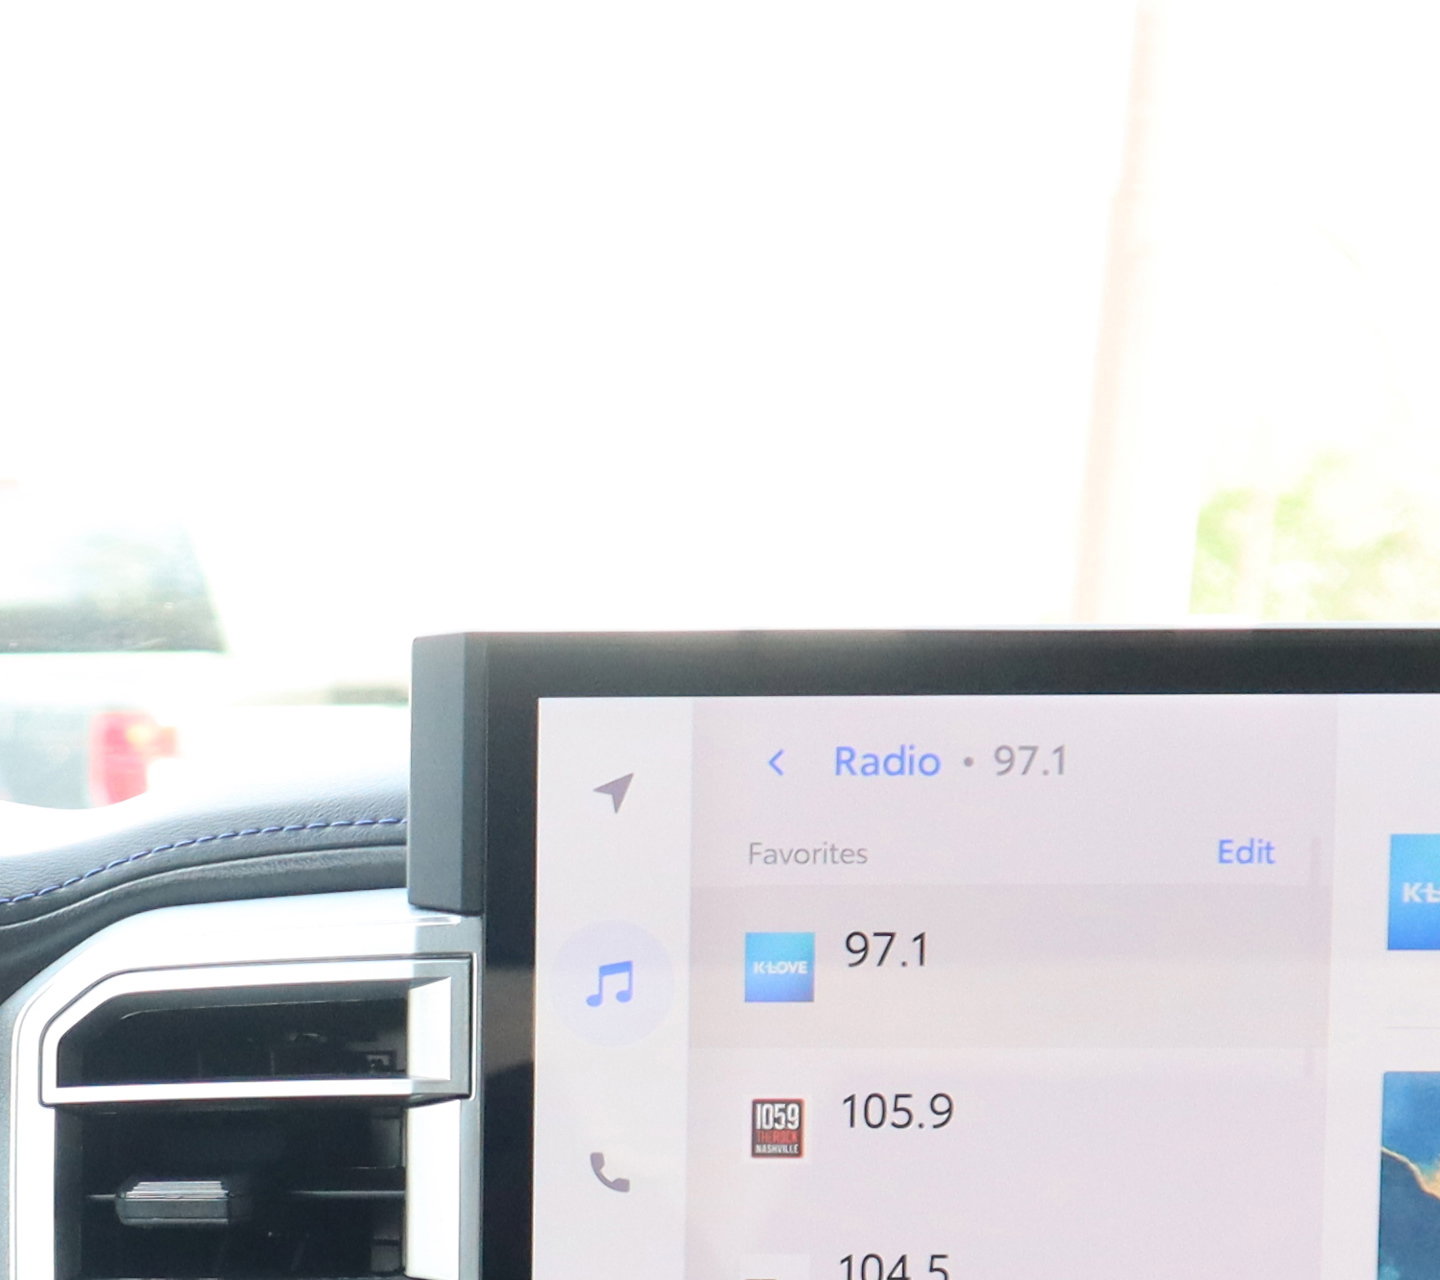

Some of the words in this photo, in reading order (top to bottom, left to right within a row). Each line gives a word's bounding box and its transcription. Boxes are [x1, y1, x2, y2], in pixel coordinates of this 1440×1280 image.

[834, 745, 941, 777] Radio
[993, 744, 1067, 777] 97.1
[747, 841, 869, 866] Favorites
[1217, 838, 1276, 864] Edit
[844, 931, 928, 968] 97.1
[840, 1093, 954, 1131] 105.9
